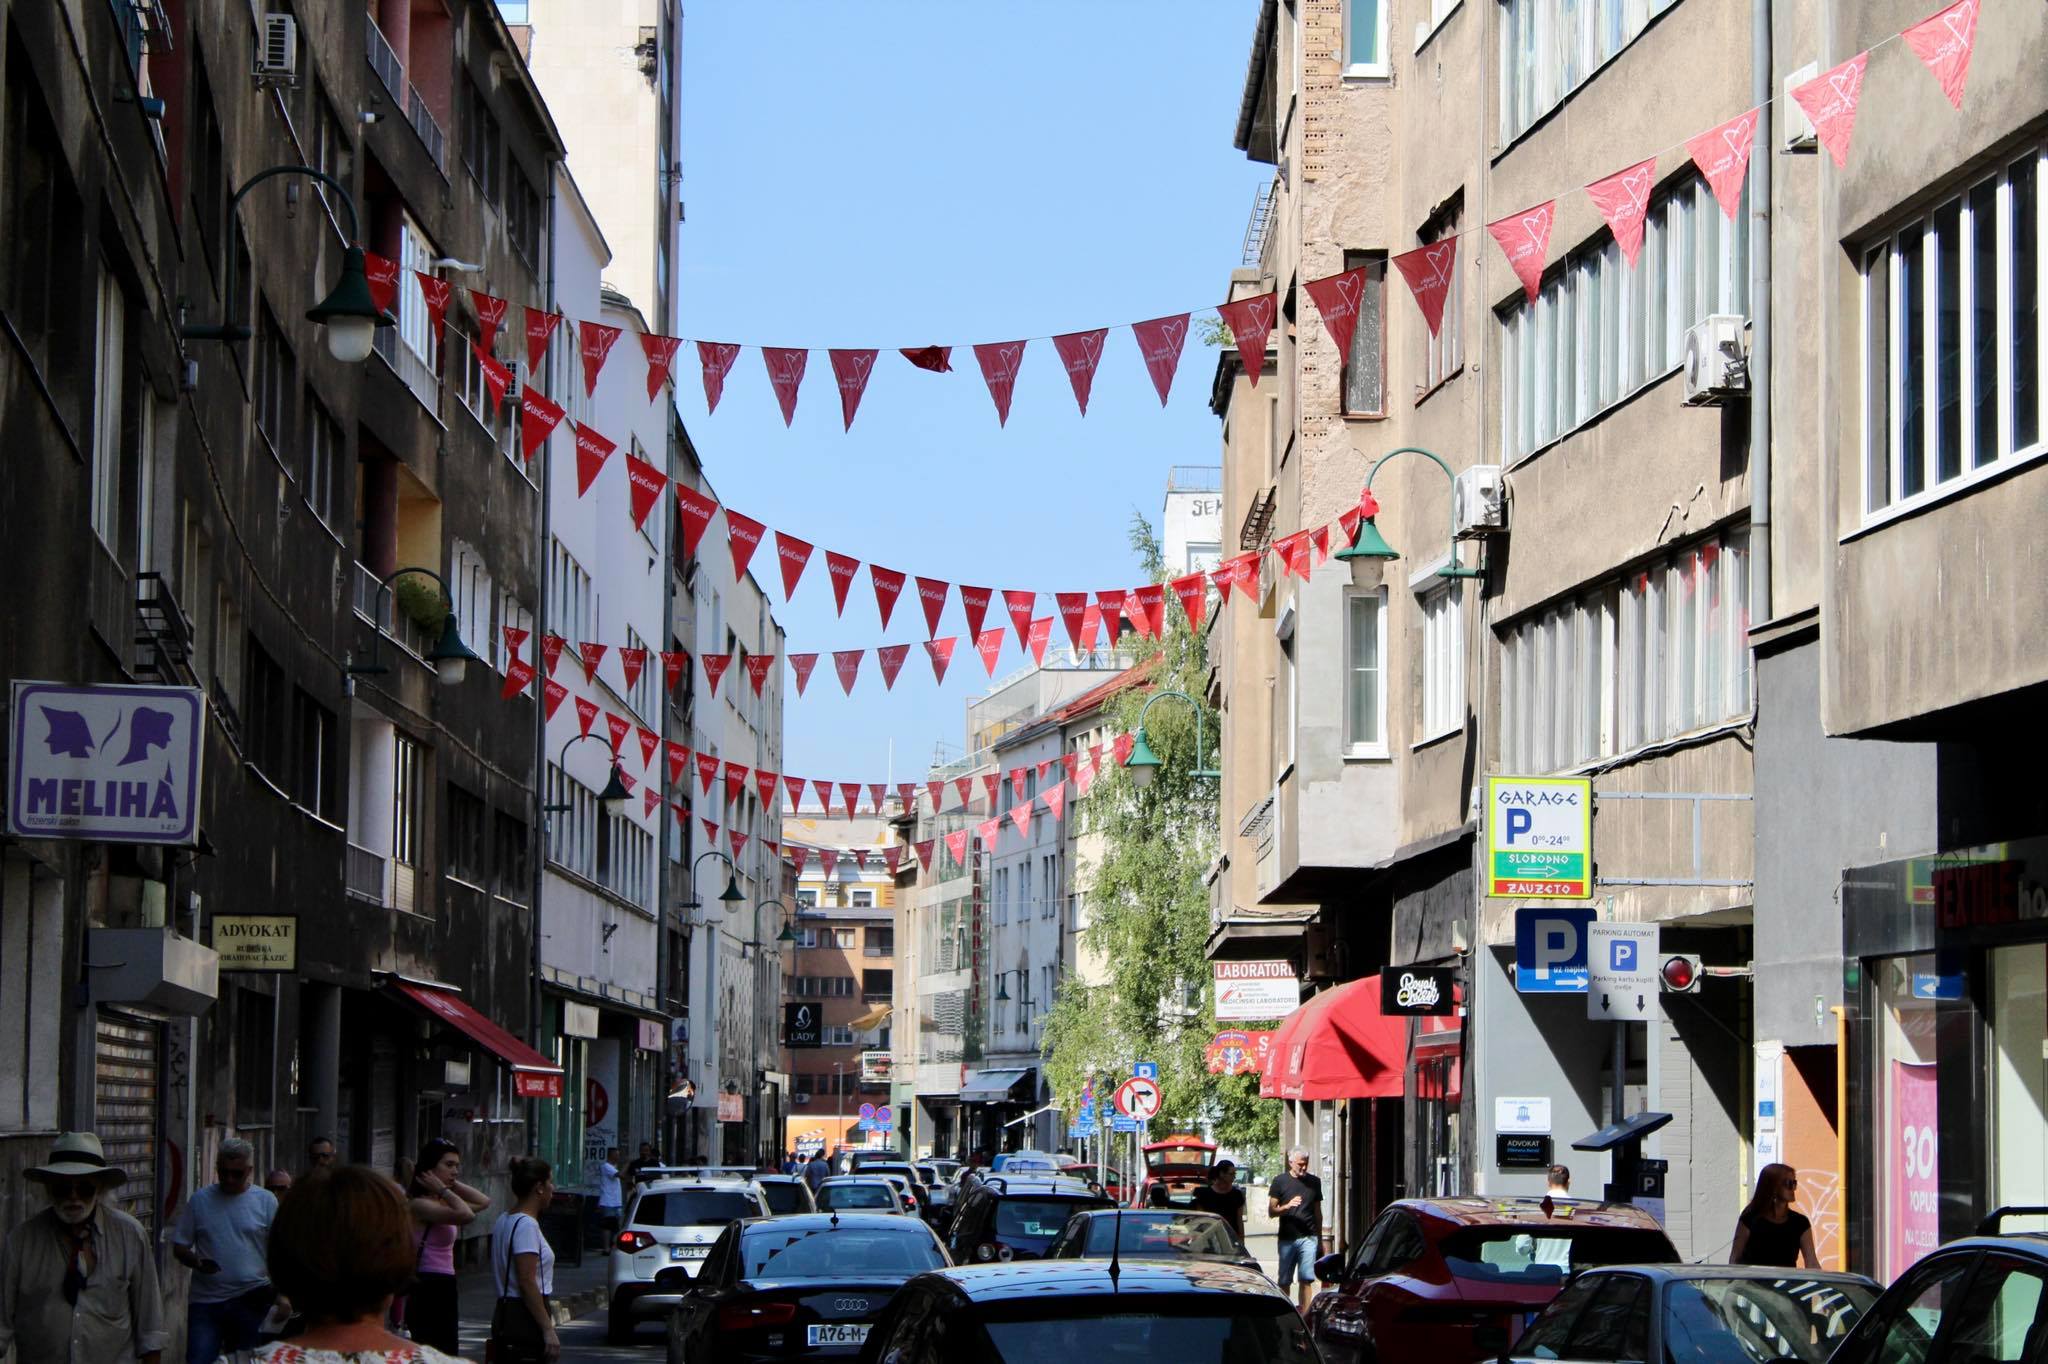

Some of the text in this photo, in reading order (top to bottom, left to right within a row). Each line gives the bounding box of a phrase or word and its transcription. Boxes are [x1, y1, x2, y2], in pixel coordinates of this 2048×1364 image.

[530, 406, 555, 426] UniCredit
[583, 440, 606, 459] UniCredit
[636, 476, 659, 494] UniCredit
[687, 503, 709, 520] UniCredit
[27, 760, 178, 819] MELIHA
[1498, 791, 1578, 806] GARAGE
[1506, 808, 1532, 844] P
[1508, 853, 1569, 864] SLOBODNO
[1507, 883, 1571, 895] ZAUZETO
[219, 924, 291, 938] ADVOKAT
[1592, 929, 1654, 938] PARKING AUTOMAT
[1534, 919, 1578, 980] P
[1615, 945, 1632, 967] P
[1592, 975, 1617, 984] Parking
[790, 1032, 815, 1041] LADY
[1644, 1178, 1655, 1191] P
